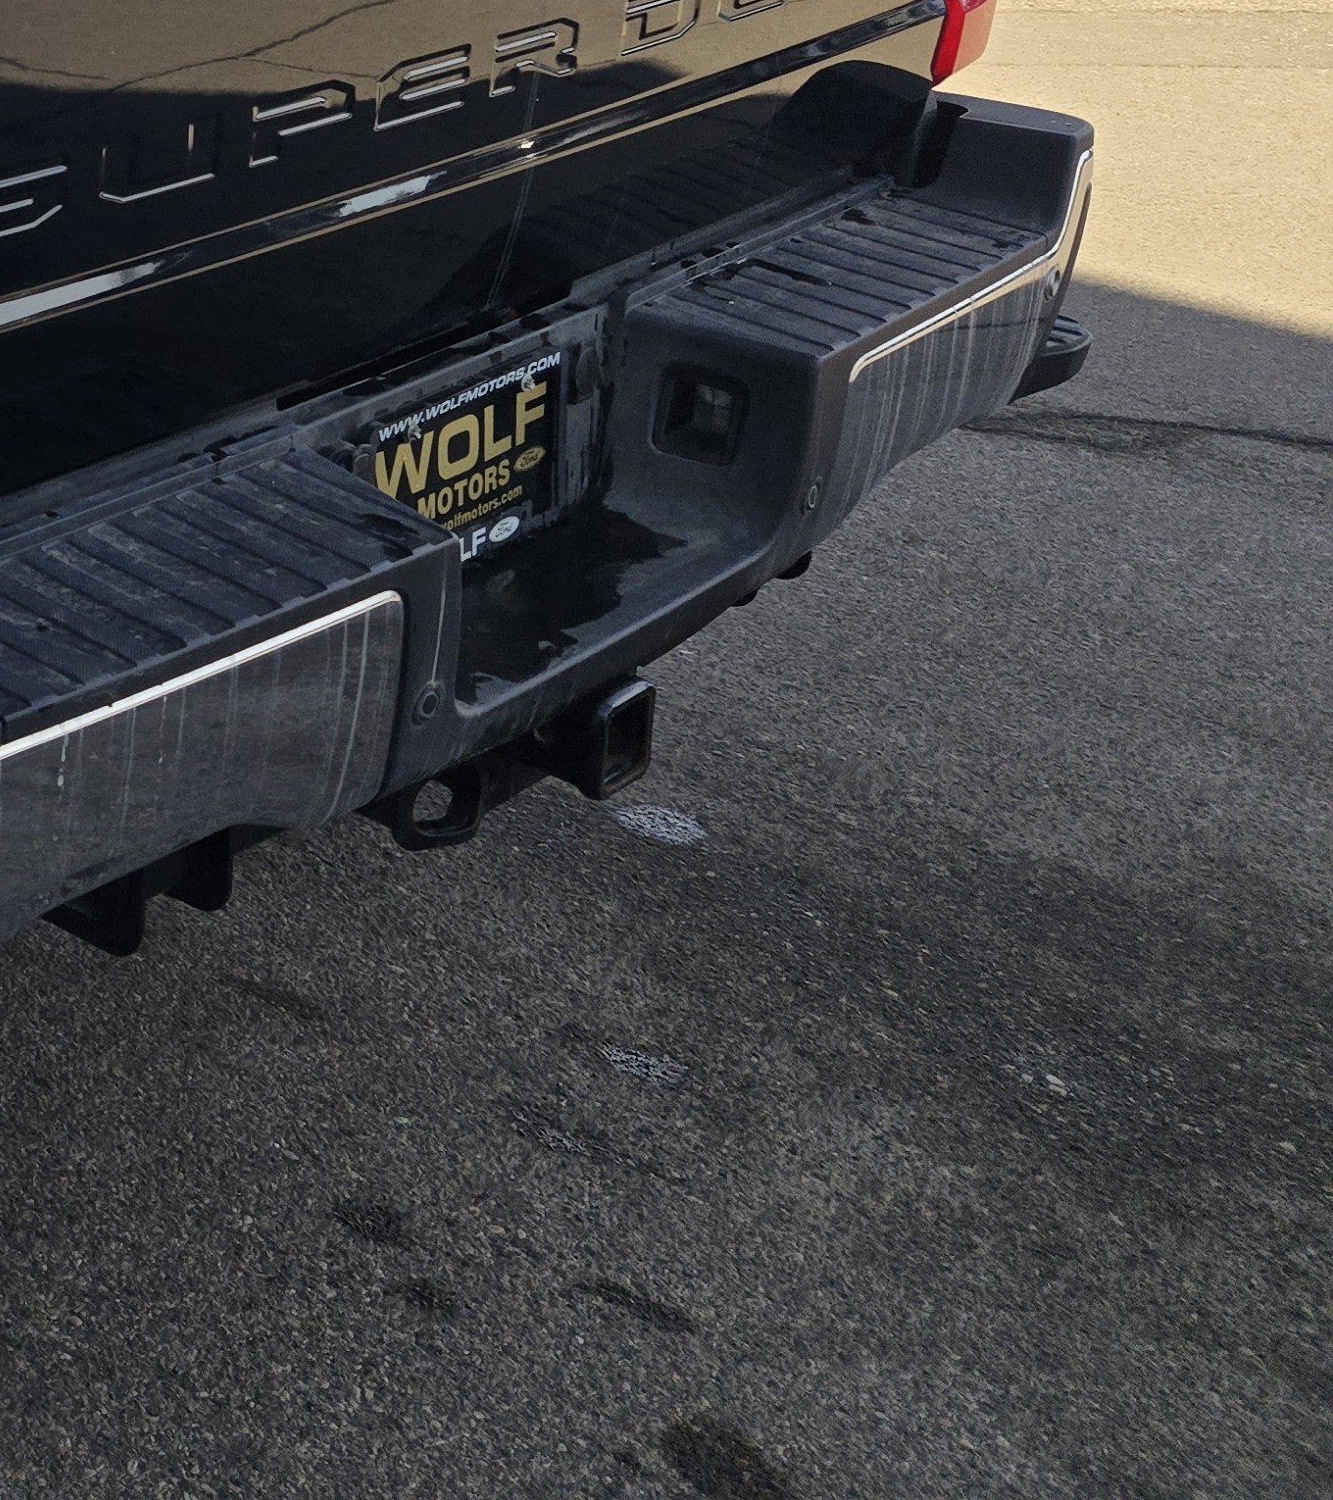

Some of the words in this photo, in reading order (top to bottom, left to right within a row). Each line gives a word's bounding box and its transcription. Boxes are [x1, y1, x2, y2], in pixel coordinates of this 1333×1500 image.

[374, 381, 548, 500] WOLF
[378, 351, 561, 442] WWW.WOLFMOTORS.COM
[417, 458, 511, 520] MOTORS
